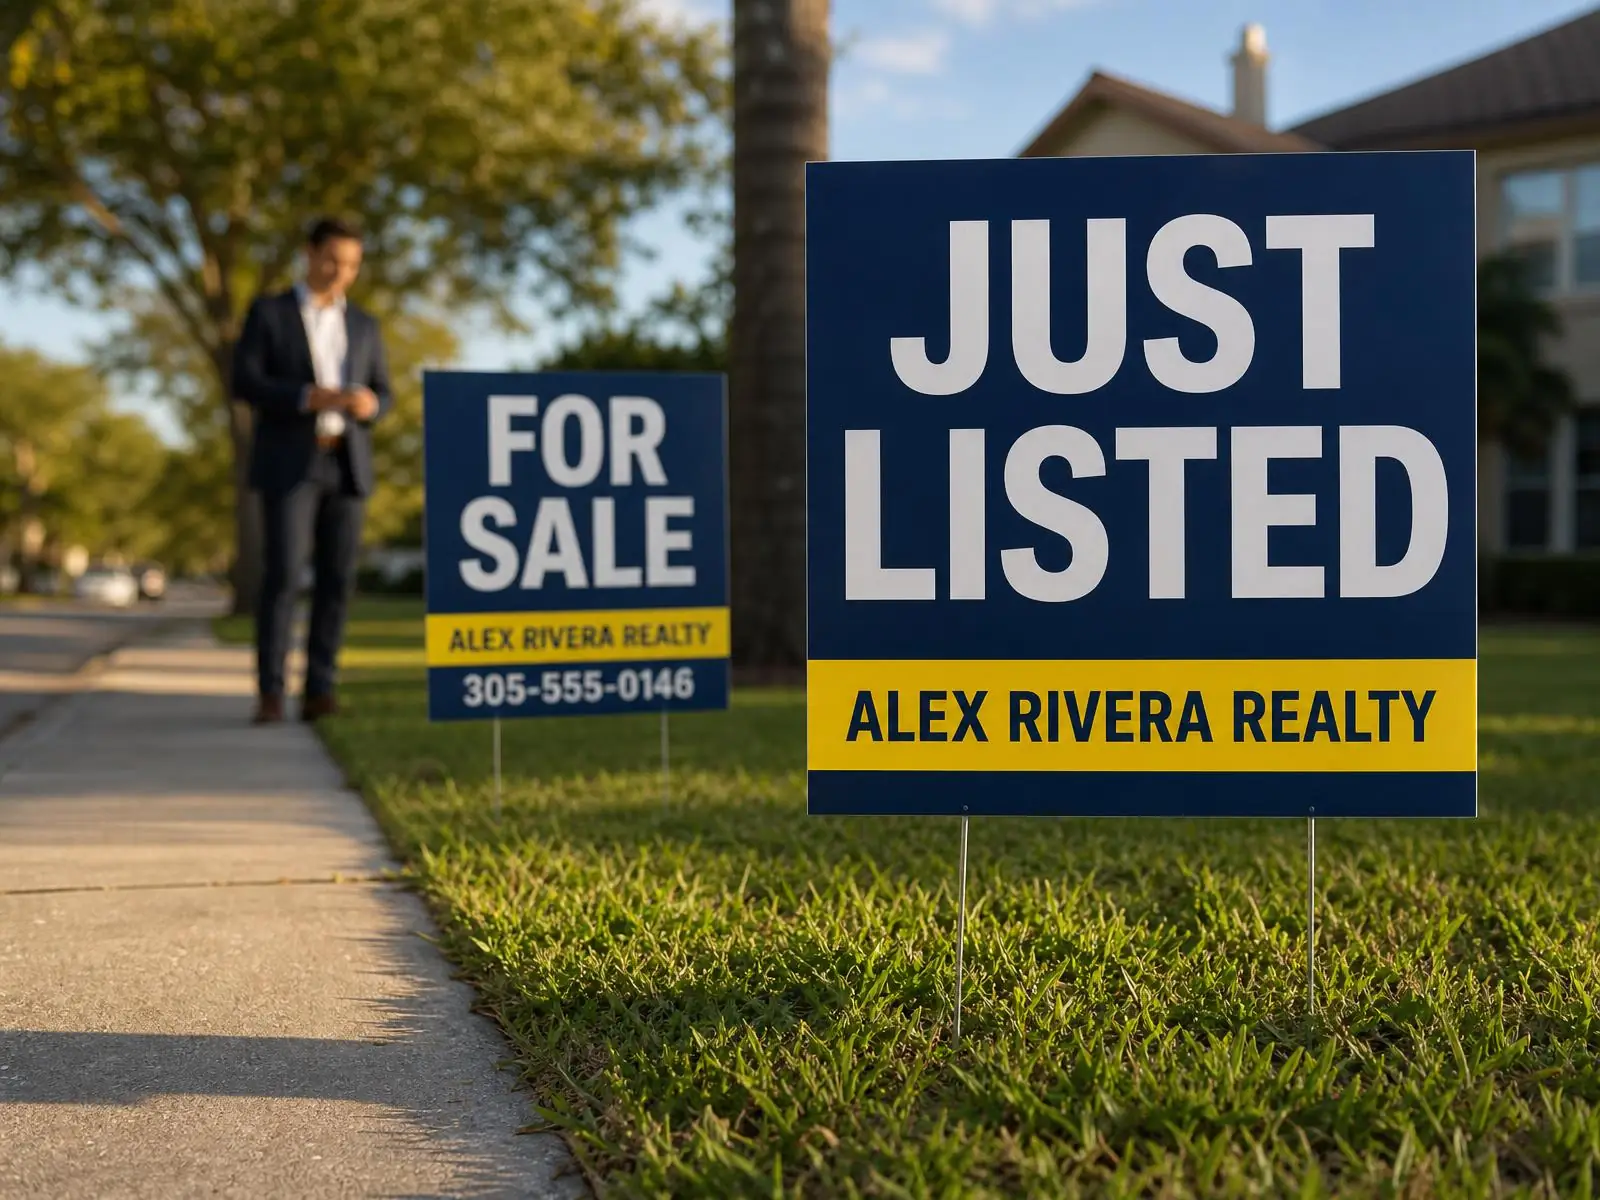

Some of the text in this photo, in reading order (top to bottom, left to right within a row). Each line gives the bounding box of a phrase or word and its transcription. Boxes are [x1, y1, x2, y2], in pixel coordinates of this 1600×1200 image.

[890, 213, 1375, 396] JUST
[487, 393, 669, 488] FOR
[458, 495, 697, 592] SALE
[844, 424, 1449, 603] LISTED
[449, 620, 713, 653] ALEX RIVERA REALTY
[462, 667, 695, 707] 305-555-0146
[846, 689, 1437, 743] ALEX RIVERA REALTY
